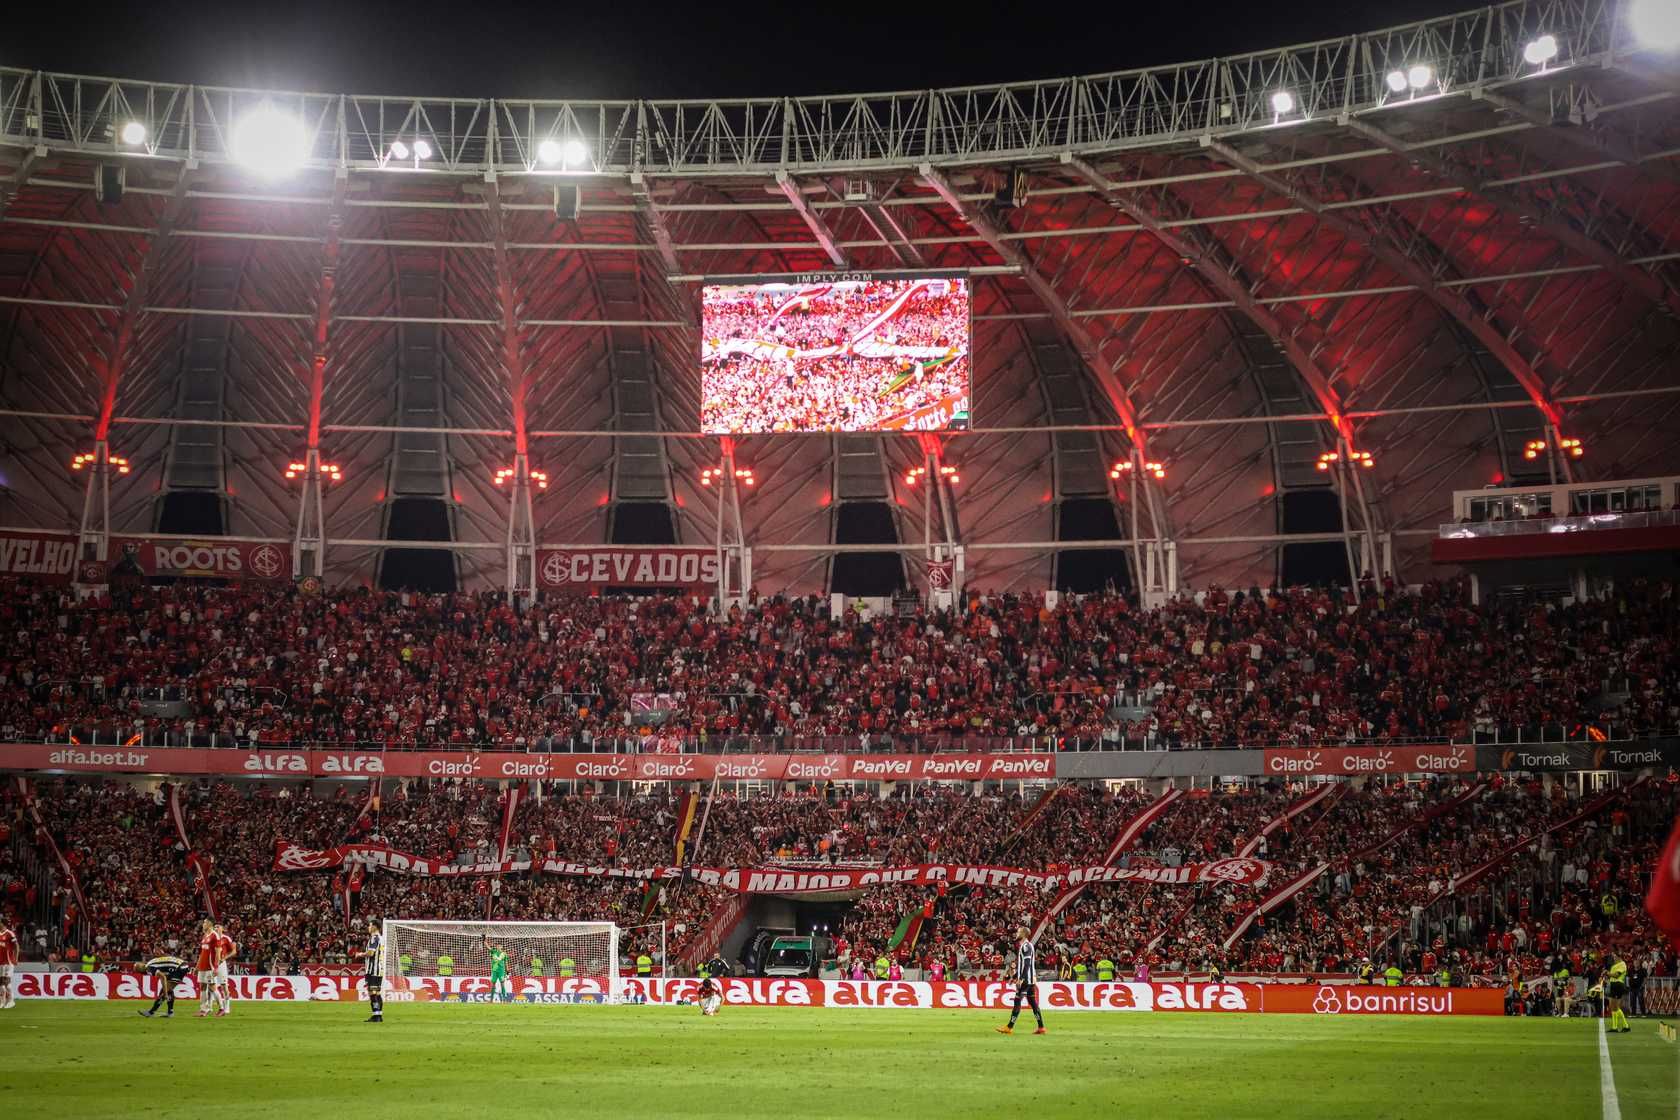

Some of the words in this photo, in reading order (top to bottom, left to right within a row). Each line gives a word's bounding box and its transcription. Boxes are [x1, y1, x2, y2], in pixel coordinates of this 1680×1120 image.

[796, 273, 873, 283] IMPLY.COM
[0, 538, 76, 575] VELHO
[154, 545, 243, 572] ROOTS
[570, 551, 719, 584] CEVADOS
[49, 749, 149, 767] alfa.bet.br
[244, 754, 307, 772] alfa
[322, 755, 385, 773] alfa
[1270, 754, 1317, 772] Claro
[1343, 753, 1389, 771] Claro
[1416, 752, 1463, 770] Claro
[1518, 752, 1570, 767] Tornak
[1610, 748, 1662, 764] Tornak
[429, 757, 475, 776] Claro
[502, 758, 549, 777] Claro
[575, 759, 621, 778] Claro
[643, 759, 689, 778] Claro
[714, 759, 761, 778] Claro
[788, 760, 834, 778] Claro
[747, 873, 851, 892] MAIOR
[18, 974, 97, 997] alfa
[726, 981, 811, 1005] alfa
[832, 982, 921, 1007] alfa
[1048, 983, 1137, 1009] alfa
[1157, 984, 1248, 1010] alfa
[1346, 989, 1453, 1012] banrisul
